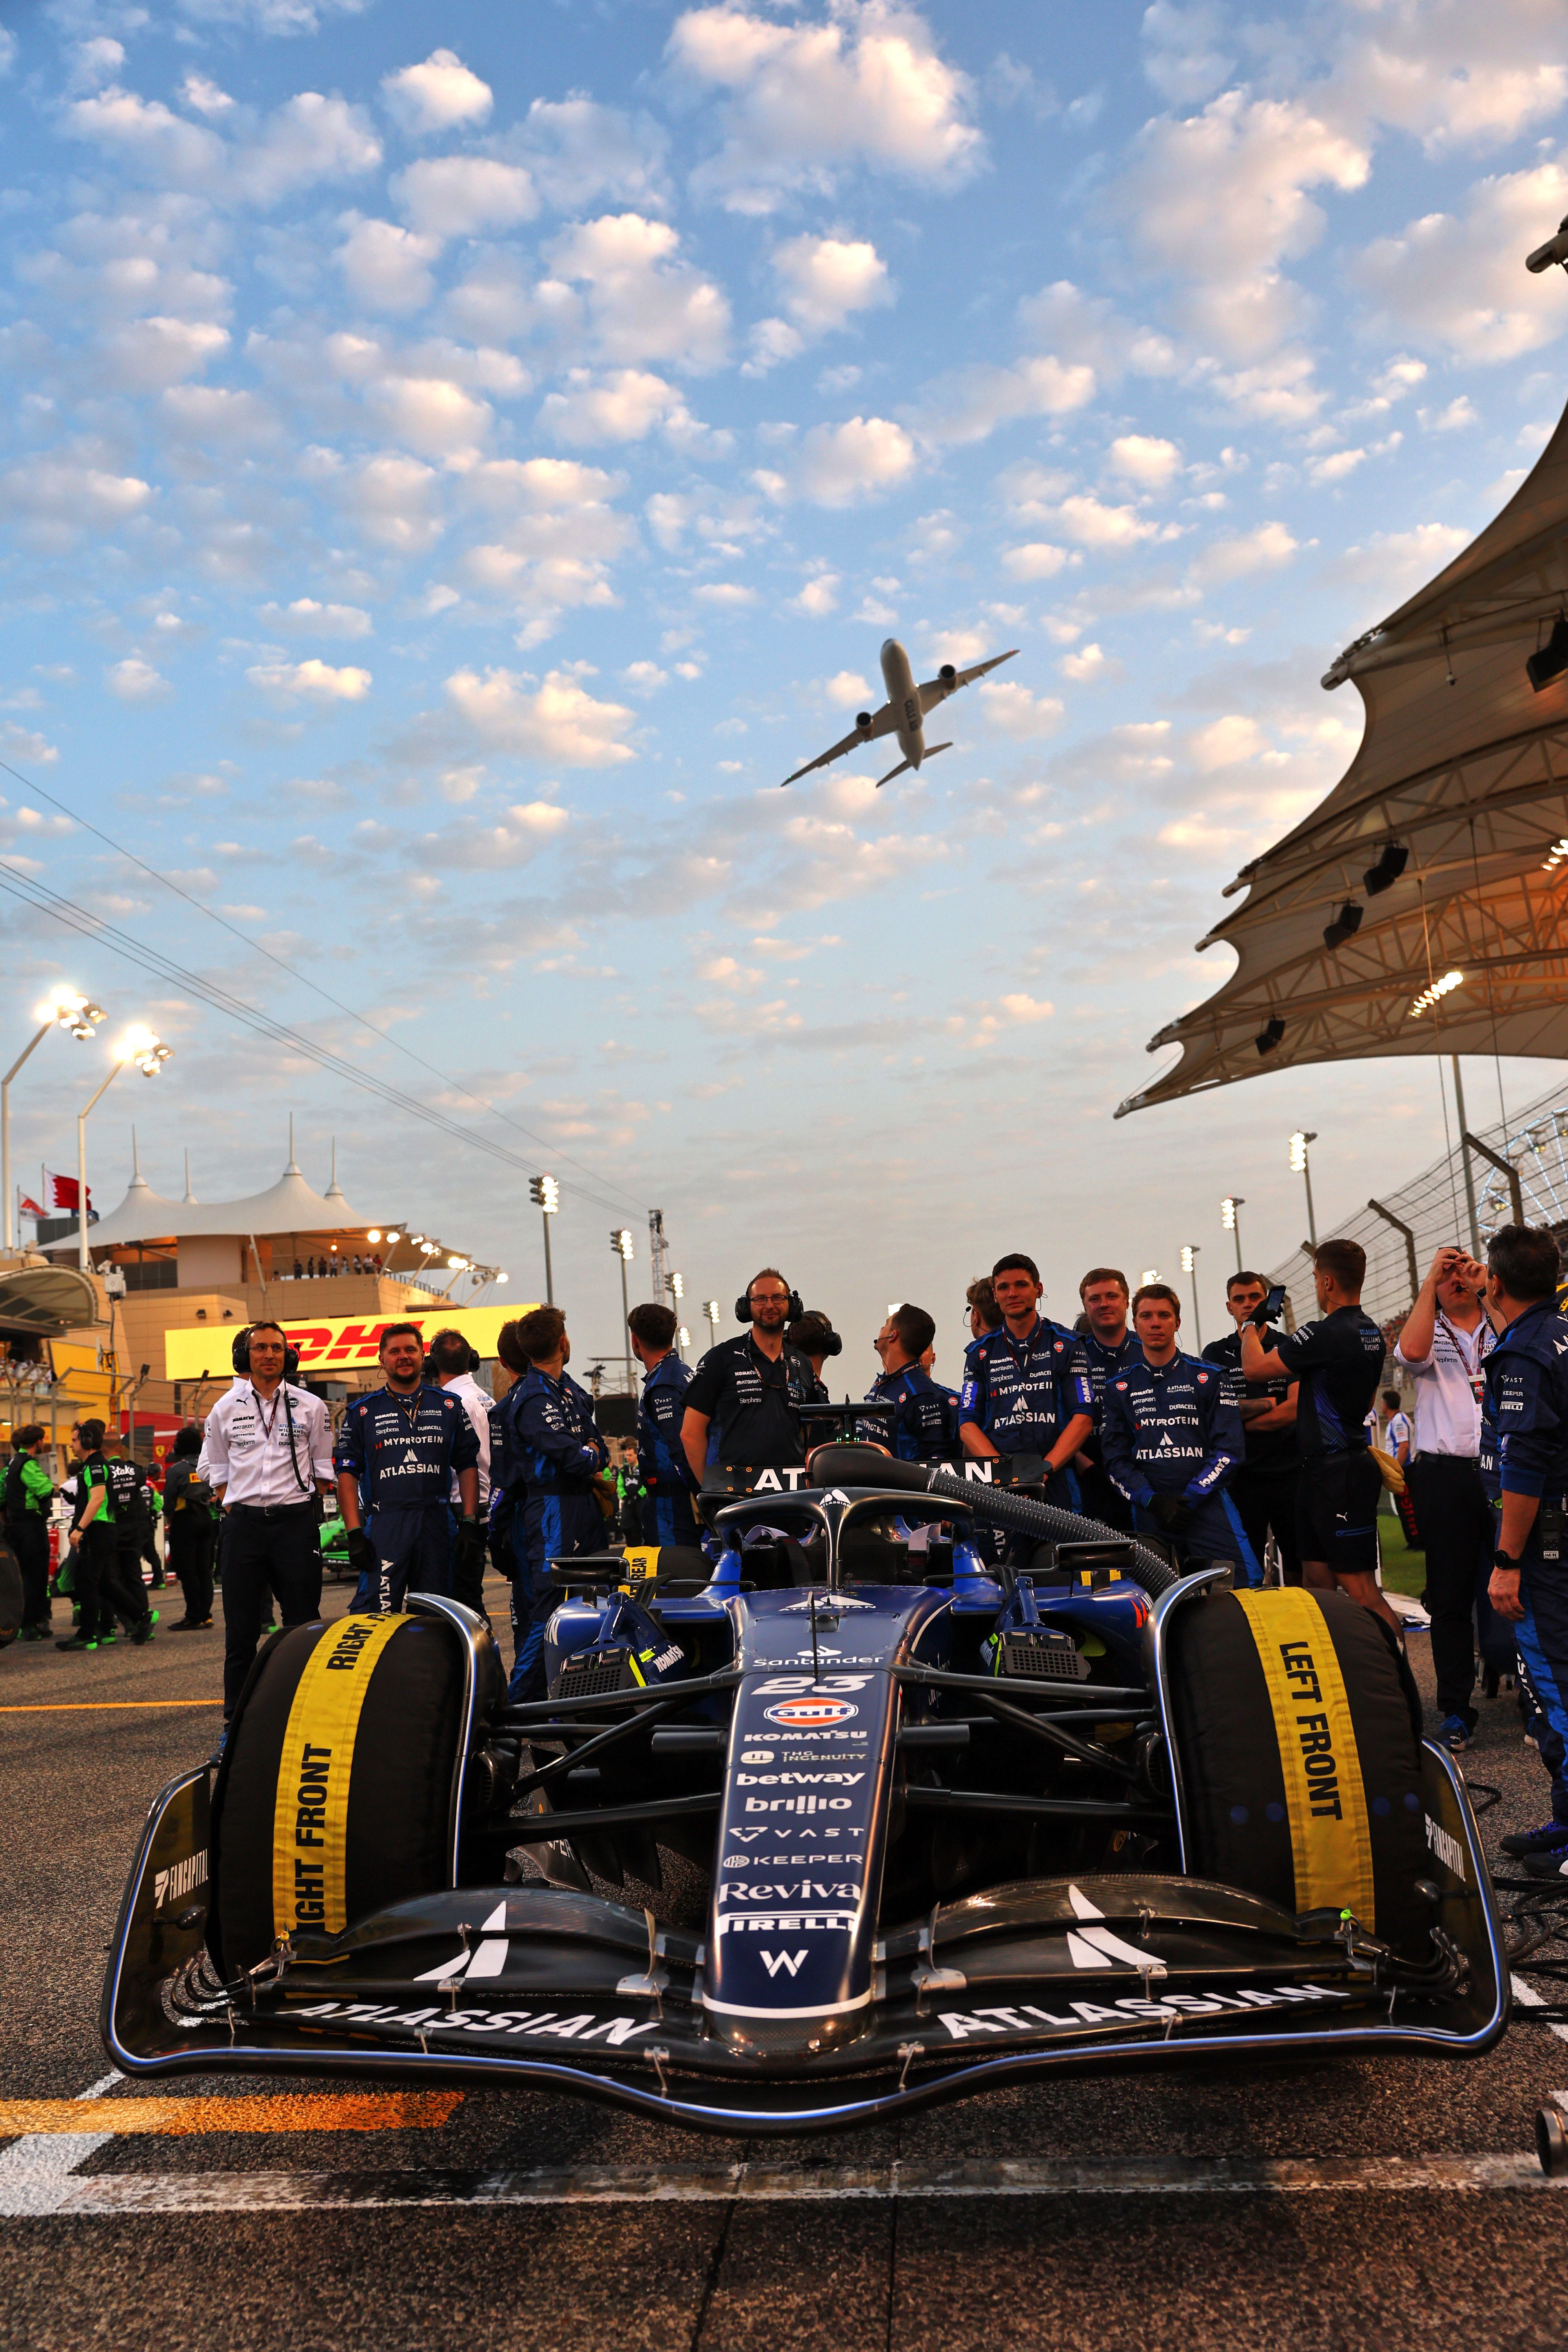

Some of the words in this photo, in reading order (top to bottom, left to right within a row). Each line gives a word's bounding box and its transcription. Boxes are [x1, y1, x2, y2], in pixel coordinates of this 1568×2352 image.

[991, 1374, 1014, 1383] Stephens
[657, 1412, 673, 1421] PIRELLI
[994, 1412, 1055, 1429] ATLASSIAN
[1141, 1416, 1199, 1426] MYPROTEIN
[376, 1427, 399, 1436] Stephens
[384, 1436, 443, 1446] MYPROTEIN
[1136, 1446, 1203, 1459] ATLASSIAN
[109, 1465, 135, 1479] Stake
[380, 1464, 440, 1480] ATLASSIAN
[820, 1501, 852, 1509] ATLASSIAN
[631, 1557, 647, 1581] REAR
[326, 1623, 378, 1670] RIGHT
[652, 1645, 684, 1673] KOMATSU
[753, 1656, 884, 1667] Santander
[1279, 1641, 1323, 1703] LEFT
[750, 1674, 875, 1695] 23
[769, 1707, 852, 1717] Gulf
[744, 1730, 867, 1742] KOMATSU
[783, 1753, 866, 1762] INGENUITY
[1296, 1712, 1343, 1820] FRONT
[736, 1772, 866, 1786] betway
[295, 1743, 332, 1848] FRONT
[774, 1828, 864, 1838] VAST
[753, 1854, 862, 1866] KEEPER
[295, 1859, 326, 1932] IGHT
[717, 1879, 861, 1904] Reviva
[715, 1910, 859, 1939] PIRELLI
[937, 1984, 1350, 2038] ATLASSIAN
[275, 2002, 661, 2045] ATLASSIAN
